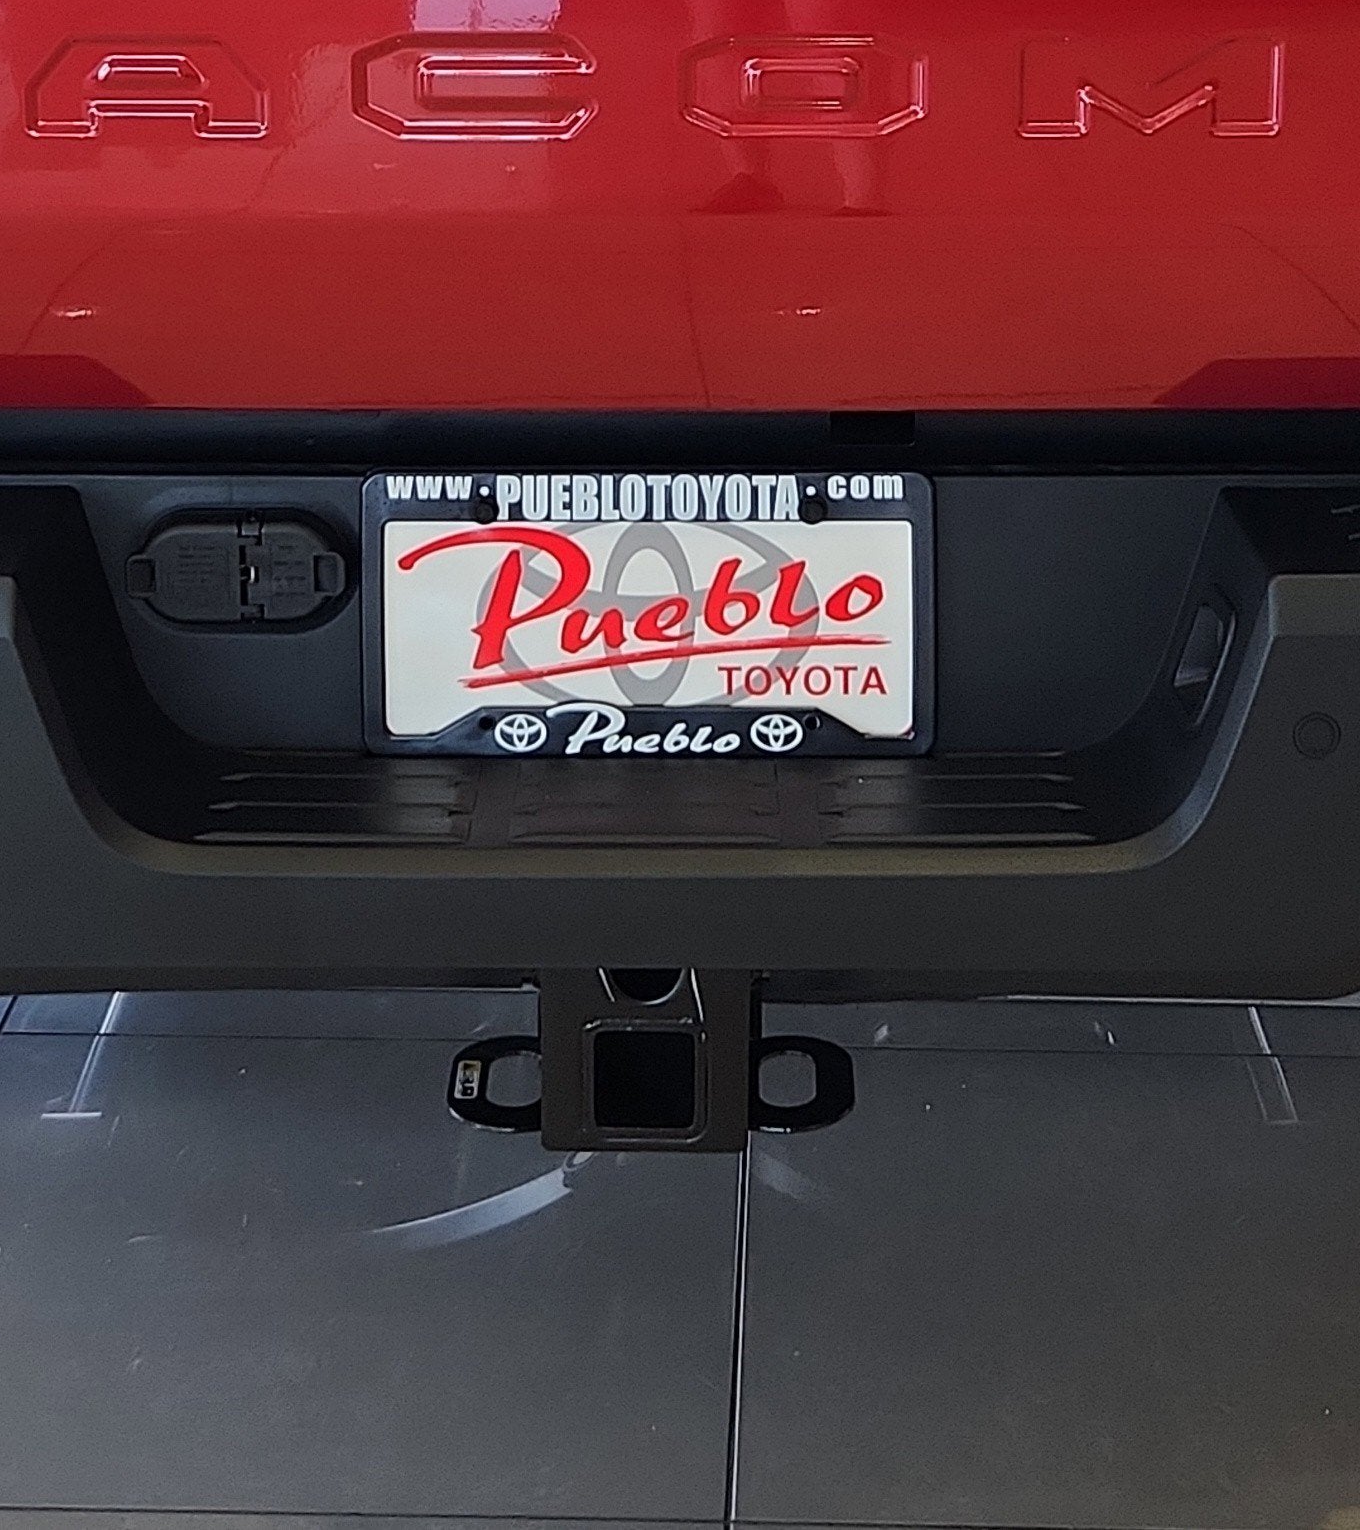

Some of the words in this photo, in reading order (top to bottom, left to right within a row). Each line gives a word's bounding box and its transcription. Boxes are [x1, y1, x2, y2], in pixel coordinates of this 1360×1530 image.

[398, 526, 883, 669] Pueblo
[718, 666, 888, 695] TOYOTA
[546, 702, 742, 755] Pueblo
